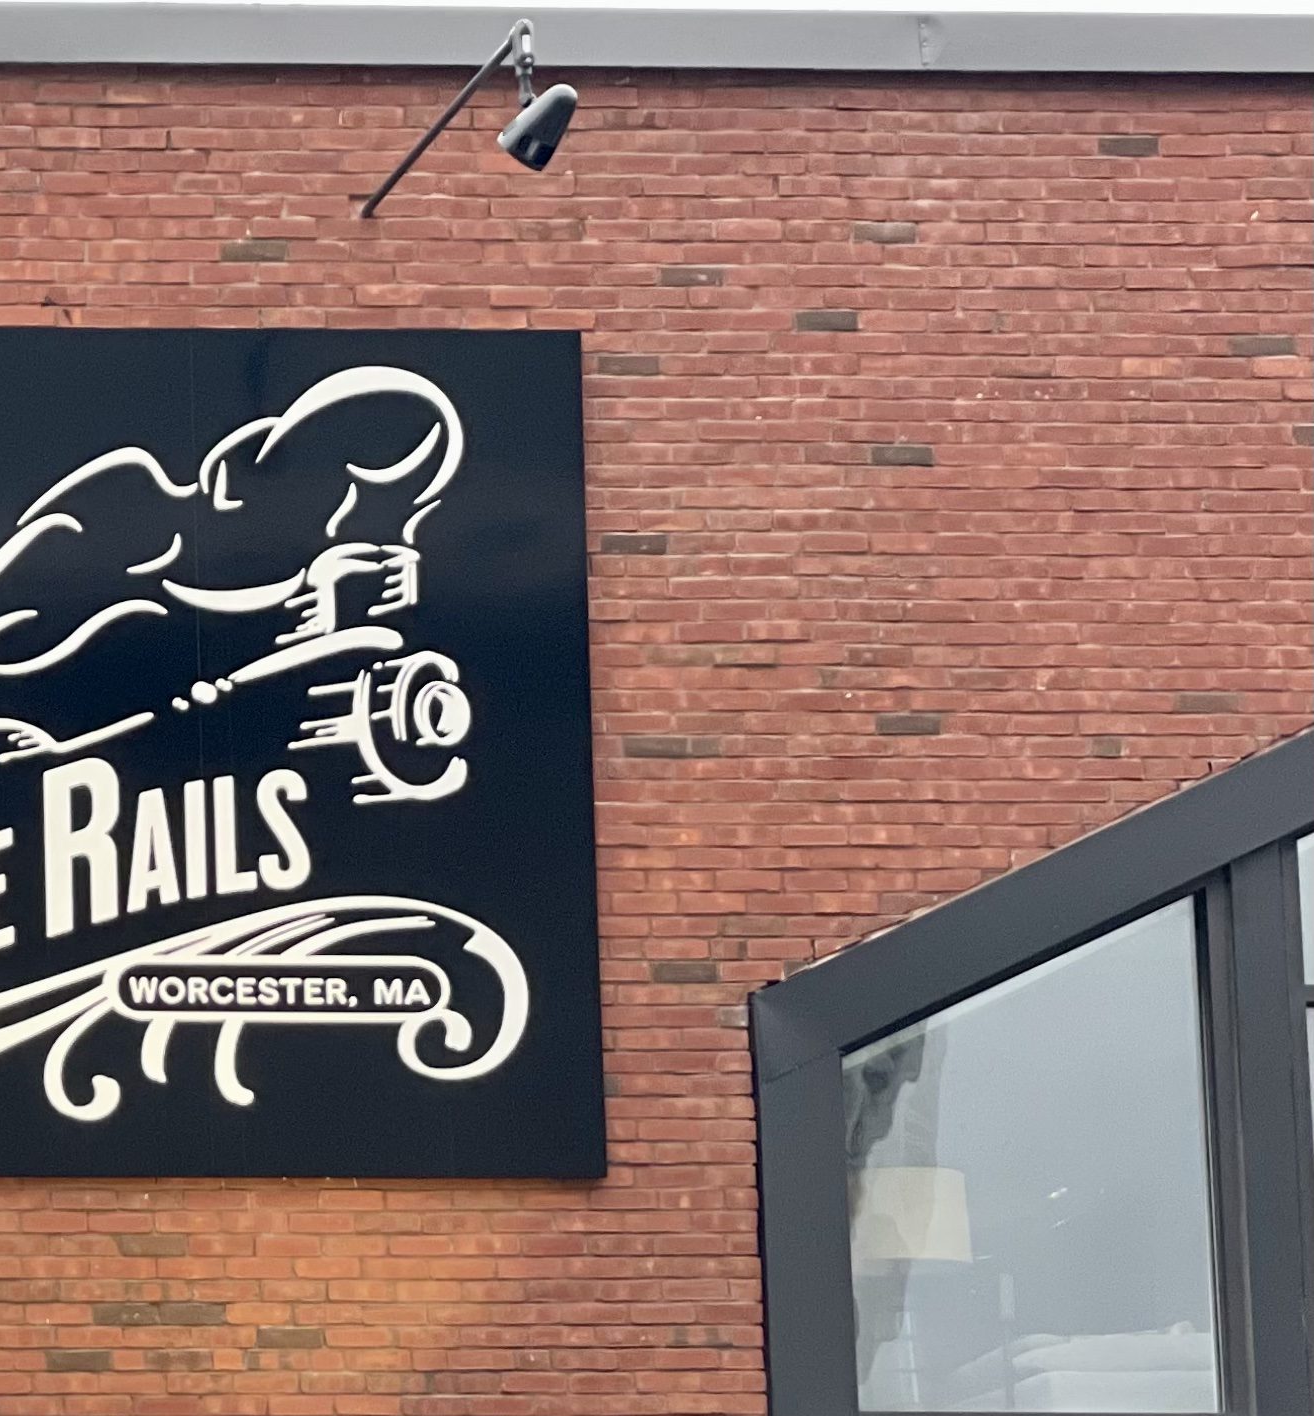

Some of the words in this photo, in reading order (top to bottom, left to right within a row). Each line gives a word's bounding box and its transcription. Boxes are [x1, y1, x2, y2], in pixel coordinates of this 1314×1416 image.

[41, 757, 312, 939] RAILS
[128, 976, 358, 1008] WORCESTER,
[373, 978, 431, 1006] MA
